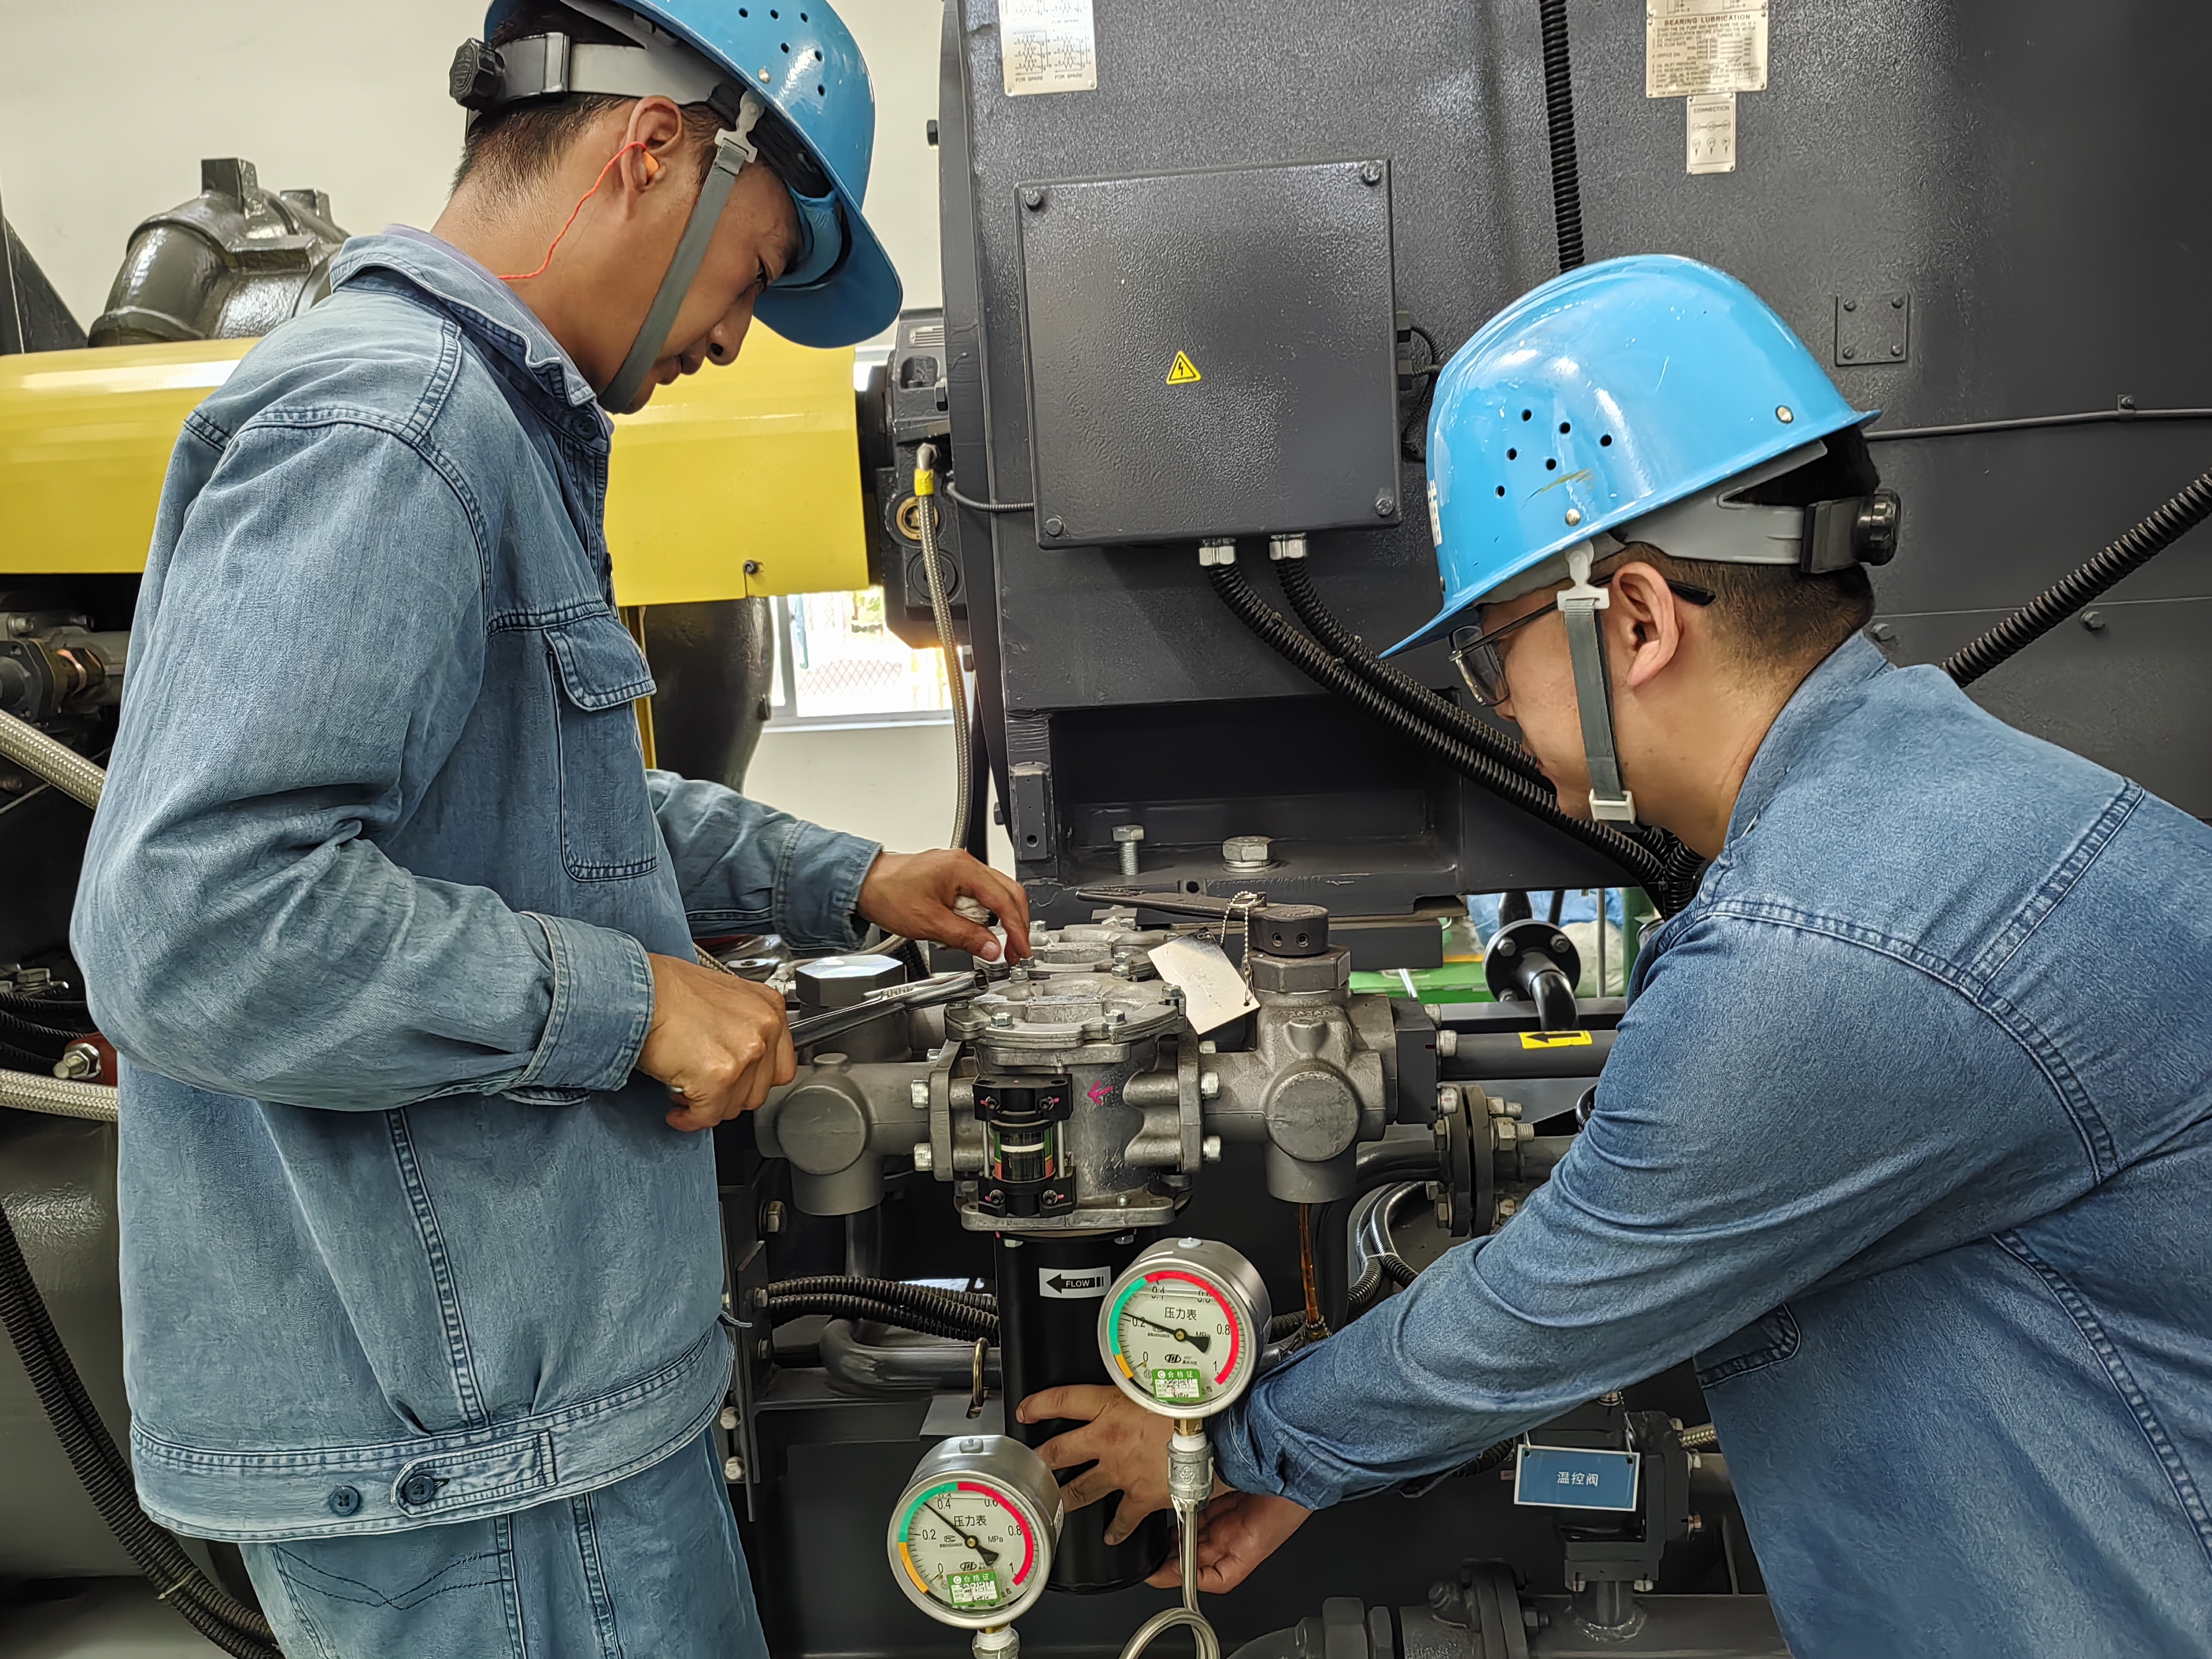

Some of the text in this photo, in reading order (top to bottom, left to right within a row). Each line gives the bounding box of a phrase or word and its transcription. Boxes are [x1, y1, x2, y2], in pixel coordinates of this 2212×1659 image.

[1664, 14, 1751, 26] BEARING LUBRICATION
[1065, 1279, 1090, 1287] FLOW
[1164, 1307, 1197, 1321] 压力表
[1132, 1316, 1146, 1327] 0.2
[1217, 1324, 1230, 1335] 0.8
[1143, 1351, 1149, 1363] 0
[1213, 1360, 1217, 1372] 1
[1557, 1471, 1599, 1487] 温控阀
[937, 1499, 952, 1510] 0.4
[954, 1515, 987, 1527] 压力表
[922, 1529, 936, 1540] 0.2
[1008, 1525, 1022, 1536] 0.8
[938, 1562, 943, 1574] 0
[1009, 1562, 1014, 1573] 1
